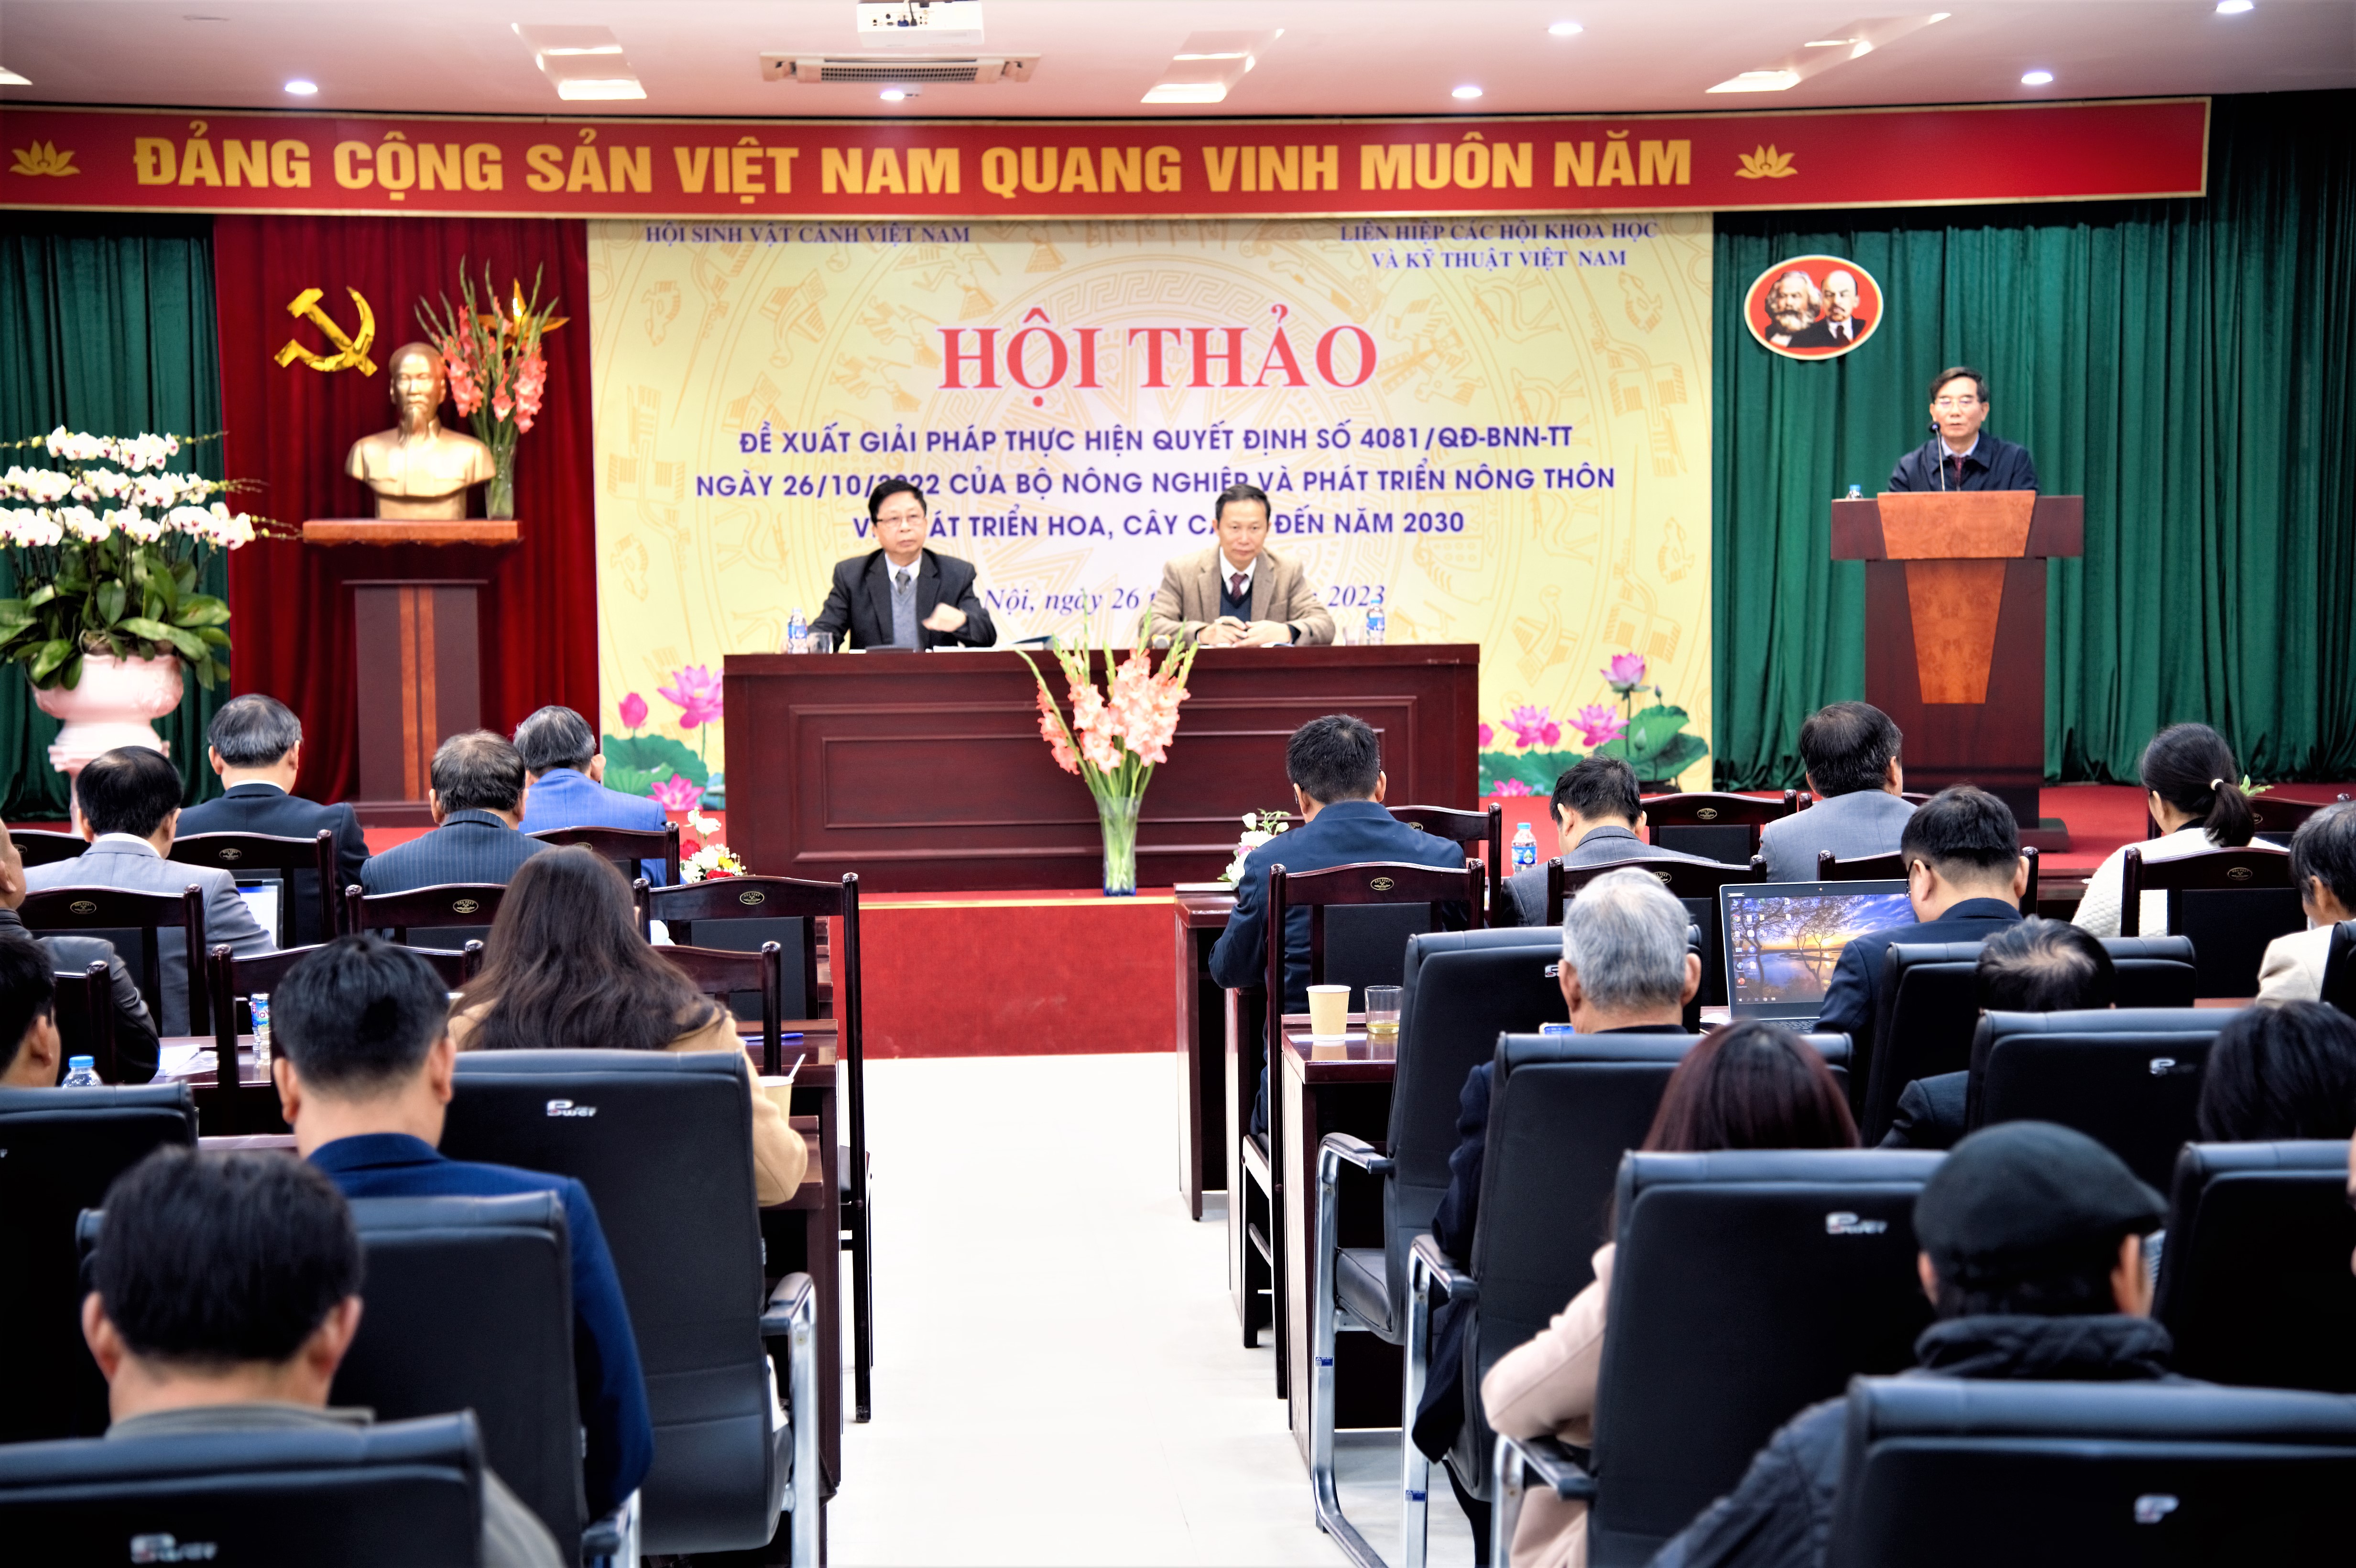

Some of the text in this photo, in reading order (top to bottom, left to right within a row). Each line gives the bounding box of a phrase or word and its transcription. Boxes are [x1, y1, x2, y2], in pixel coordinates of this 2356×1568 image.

[133, 120, 1690, 204] ĐẢNG CỘNG SẢN VIỆT NAM QUANG VINH MUÔN NĂM
[647, 220, 969, 248] HỘI SINH VẬT CẢNH VIỆT NAM
[1341, 218, 1658, 245] LIÊN HIỆP CÁC HỘI KHOA HỌC
[1371, 246, 1626, 272] VÀ KỸ THUẬT VIỆT NAM
[939, 305, 1376, 407] HỘI THẢO
[740, 420, 1572, 457] ĐỀ XUẤT GIẢI PHÁP THỰC HIỆN QUYẾT ĐỊNH SỐ 4081/QĐ-BNN-TT
[697, 470, 772, 496] NGÀY
[949, 466, 1006, 495] CỦA
[1016, 468, 1052, 500] BỘ
[1063, 467, 1142, 494] NÔNG
[1258, 466, 1293, 492] VÀ
[1303, 465, 1368, 491] PHÁT
[1377, 458, 1445, 490] TRIỂN
[1456, 464, 1534, 490] NÔNG
[1544, 462, 1614, 489] THÔN
[853, 518, 875, 538] V
[929, 511, 960, 537] ÁT
[969, 504, 1037, 537] TRIỂN
[1048, 516, 1113, 539] HOA,
[1123, 510, 1178, 536] CÂY
[1274, 505, 1323, 534] ĐẾN
[1334, 508, 1393, 534] NĂM
[1404, 512, 1464, 533] 2030
[1112, 588, 1140, 609] 26
[1328, 586, 1385, 607] 2023
